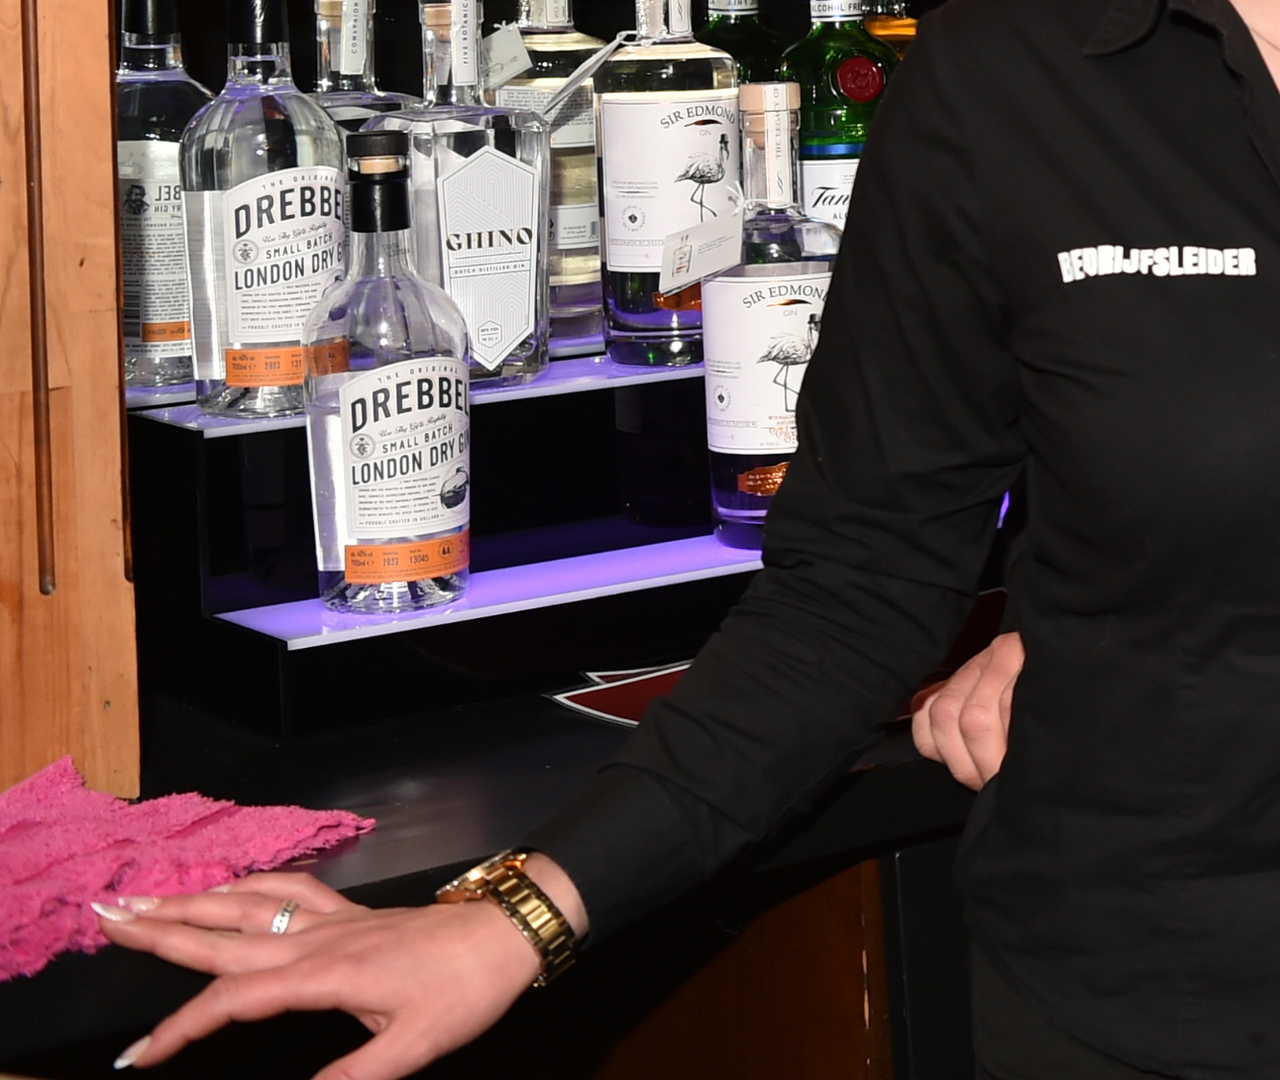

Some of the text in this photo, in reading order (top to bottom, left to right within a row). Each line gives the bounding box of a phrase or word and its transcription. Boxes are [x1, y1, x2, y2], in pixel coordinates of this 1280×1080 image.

[660, 104, 736, 130] SIR EDMOND
[699, 129, 712, 137] GIN
[265, 231, 333, 260] SMALL BATCH
[445, 226, 534, 252] GHINO
[234, 257, 305, 291] LONDON
[311, 246, 335, 274] DRY
[454, 267, 477, 275] DUTCH
[479, 264, 511, 272] DISTILLED
[1057, 245, 1257, 284] BEDRIJFSLEIDER
[742, 290, 766, 309] SIR
[378, 365, 459, 384] THE ORIGINAL
[350, 376, 469, 434] DREBBEL
[382, 423, 453, 454] SMALL BATCH
[351, 451, 422, 486] LONDON
[429, 437, 455, 467] DRY
[409, 554, 430, 565] 13045
